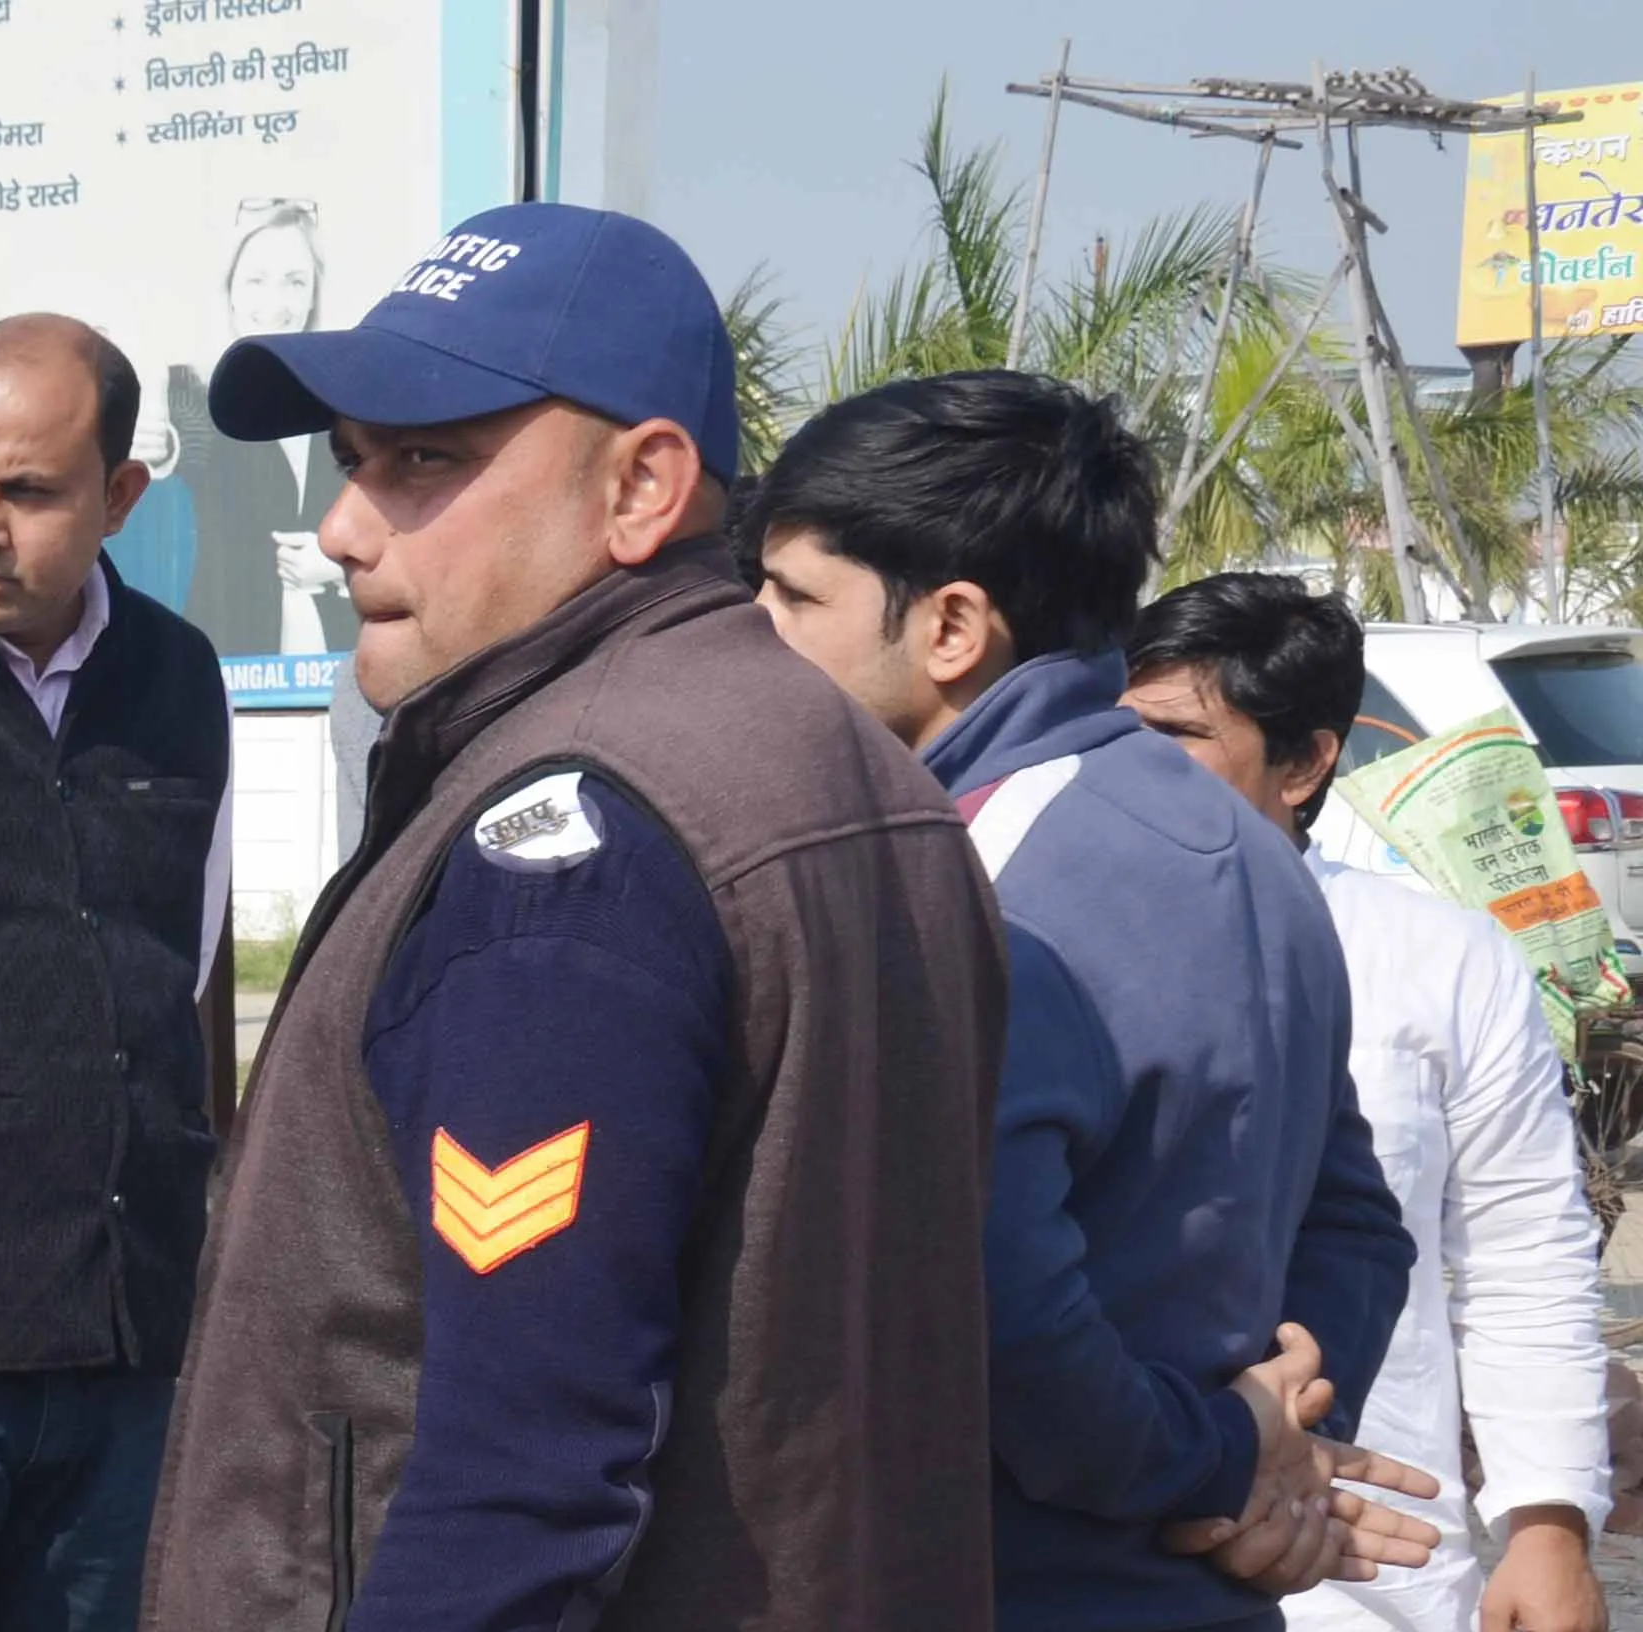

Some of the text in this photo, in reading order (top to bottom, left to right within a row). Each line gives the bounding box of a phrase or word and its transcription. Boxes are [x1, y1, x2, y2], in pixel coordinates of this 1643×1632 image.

[232, 47, 266, 82] की
[271, 41, 350, 91] सुविधा
[253, 109, 300, 144] पूल
[423, 232, 522, 273] AFFIC
[394, 264, 476, 302] LICE
[220, 660, 341, 691] ANGAL 992
